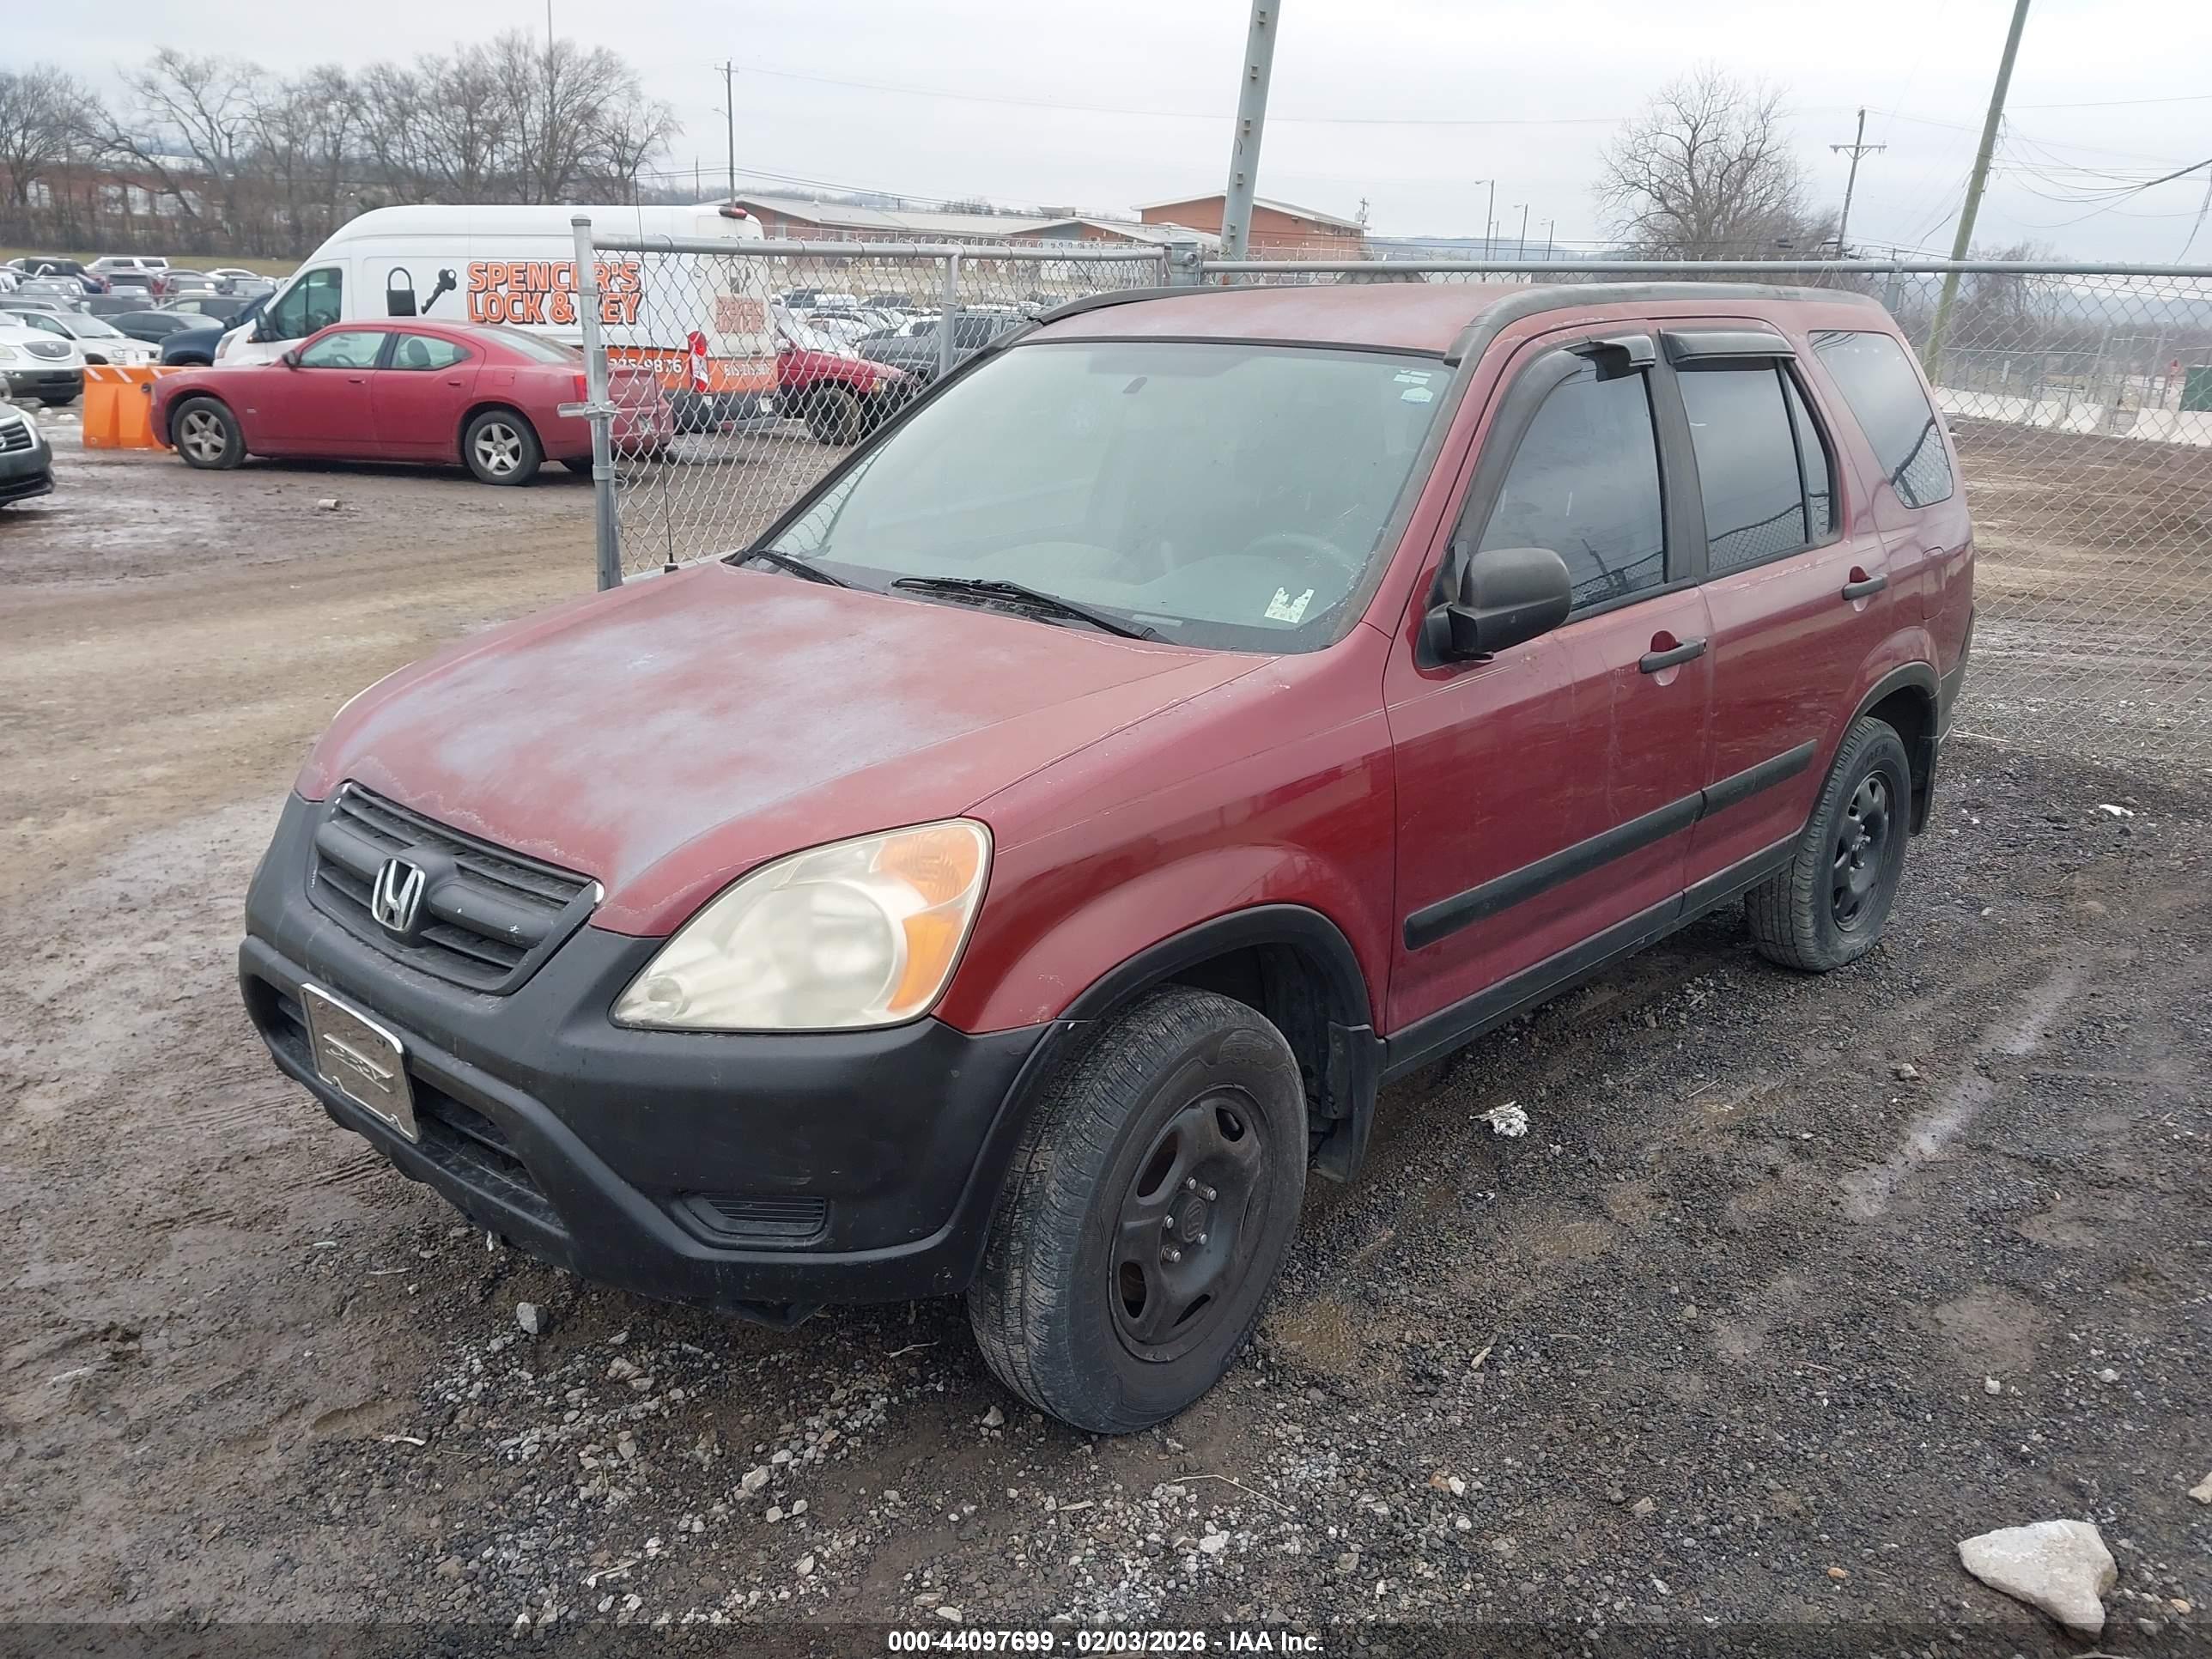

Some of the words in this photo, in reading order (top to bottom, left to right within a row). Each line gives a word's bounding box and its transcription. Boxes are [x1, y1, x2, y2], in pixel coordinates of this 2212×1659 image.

[466, 290, 547, 325] LOCK
[549, 290, 578, 325] &
[598, 291, 643, 325] EY
